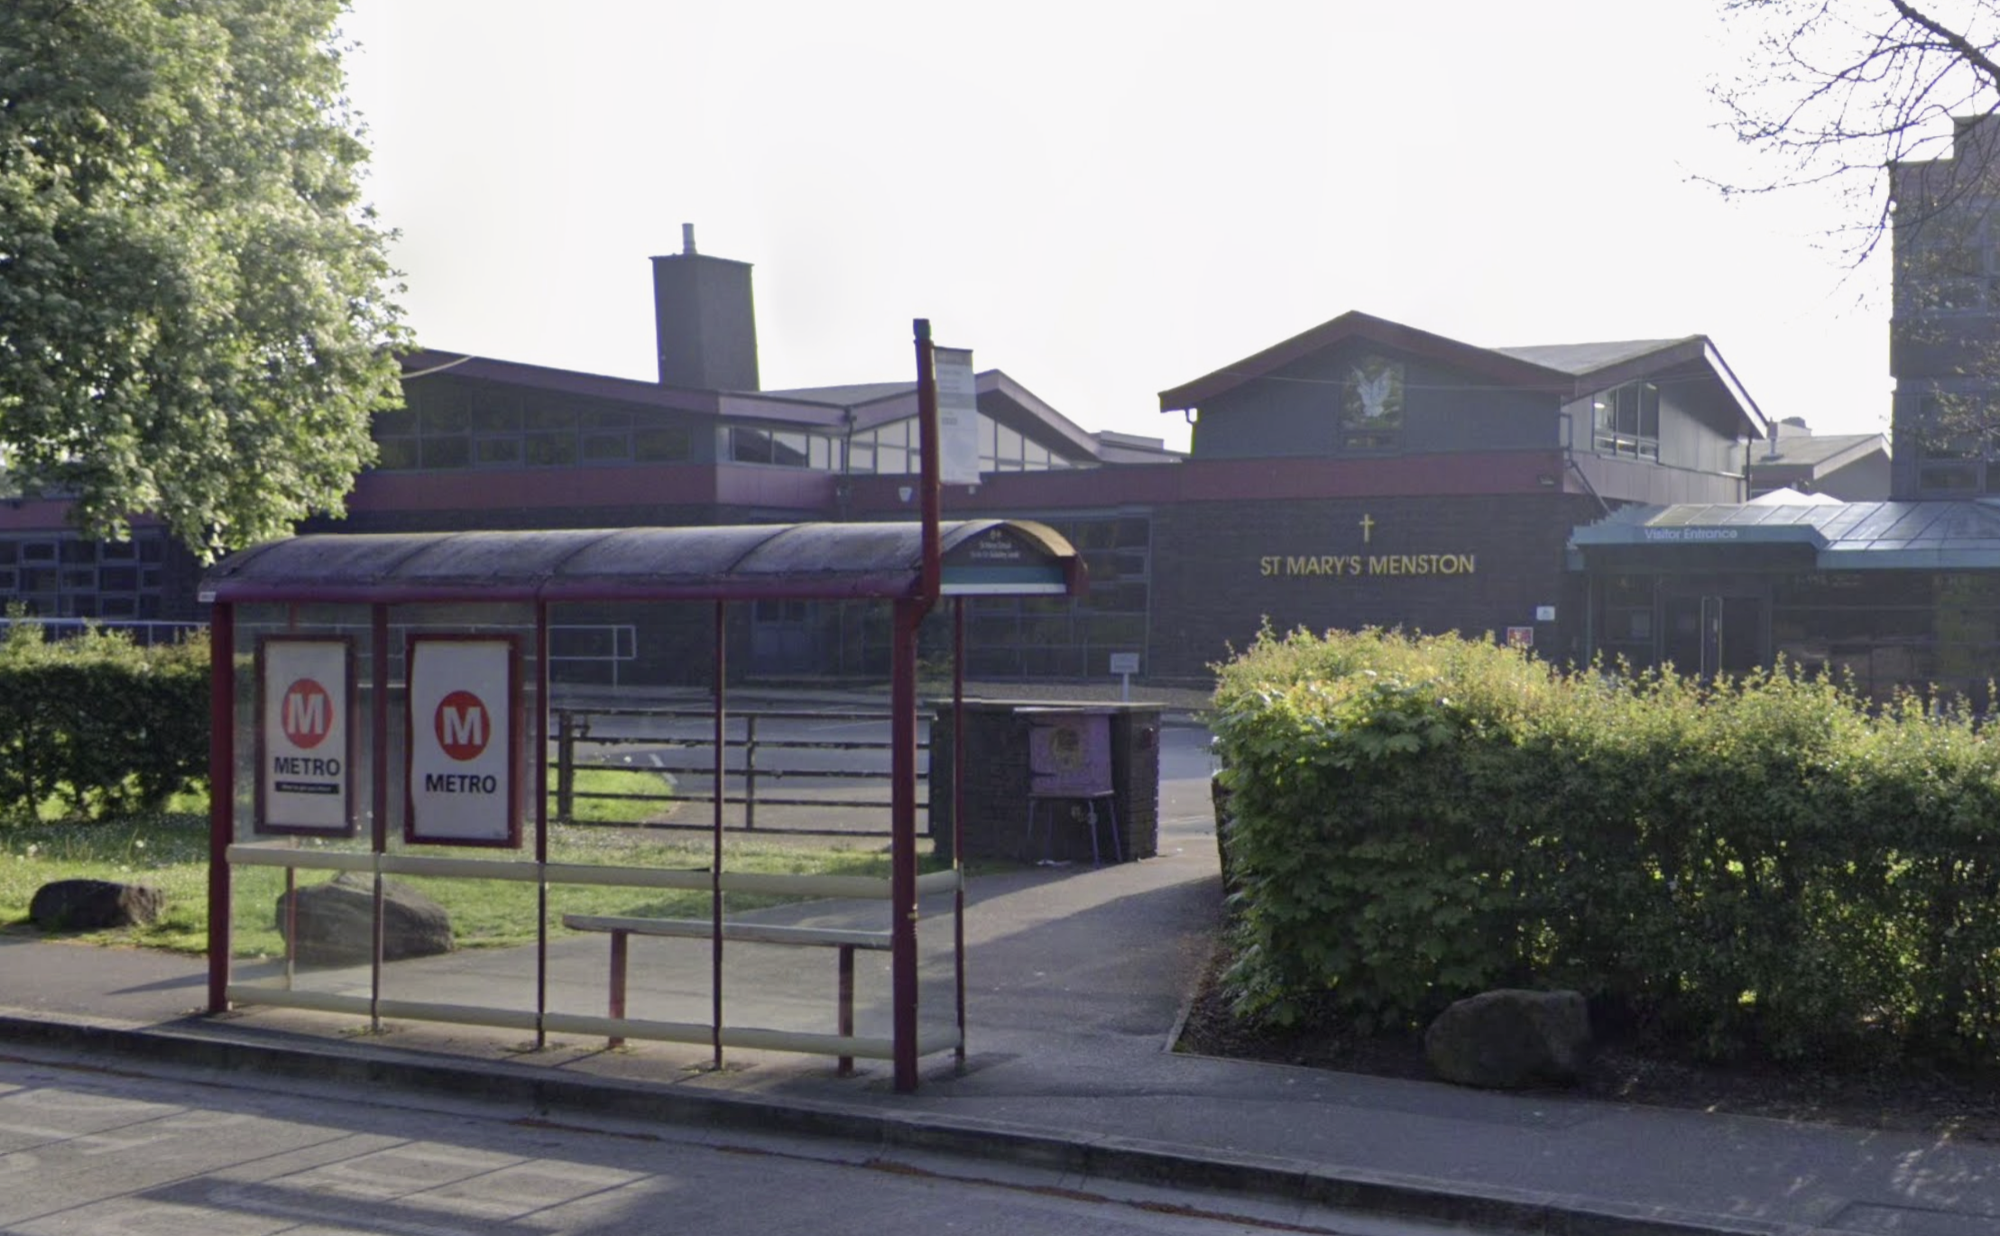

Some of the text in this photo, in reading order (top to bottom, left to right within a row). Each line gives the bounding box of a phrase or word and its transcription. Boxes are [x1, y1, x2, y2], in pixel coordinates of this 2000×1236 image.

[1644, 527, 1738, 540] Visitor Entrance
[1260, 554, 1475, 576] ST MARY'S MENSTON
[287, 693, 325, 735] M
[442, 706, 483, 746] M
[274, 756, 341, 777] METRO
[425, 773, 497, 794] METRO
